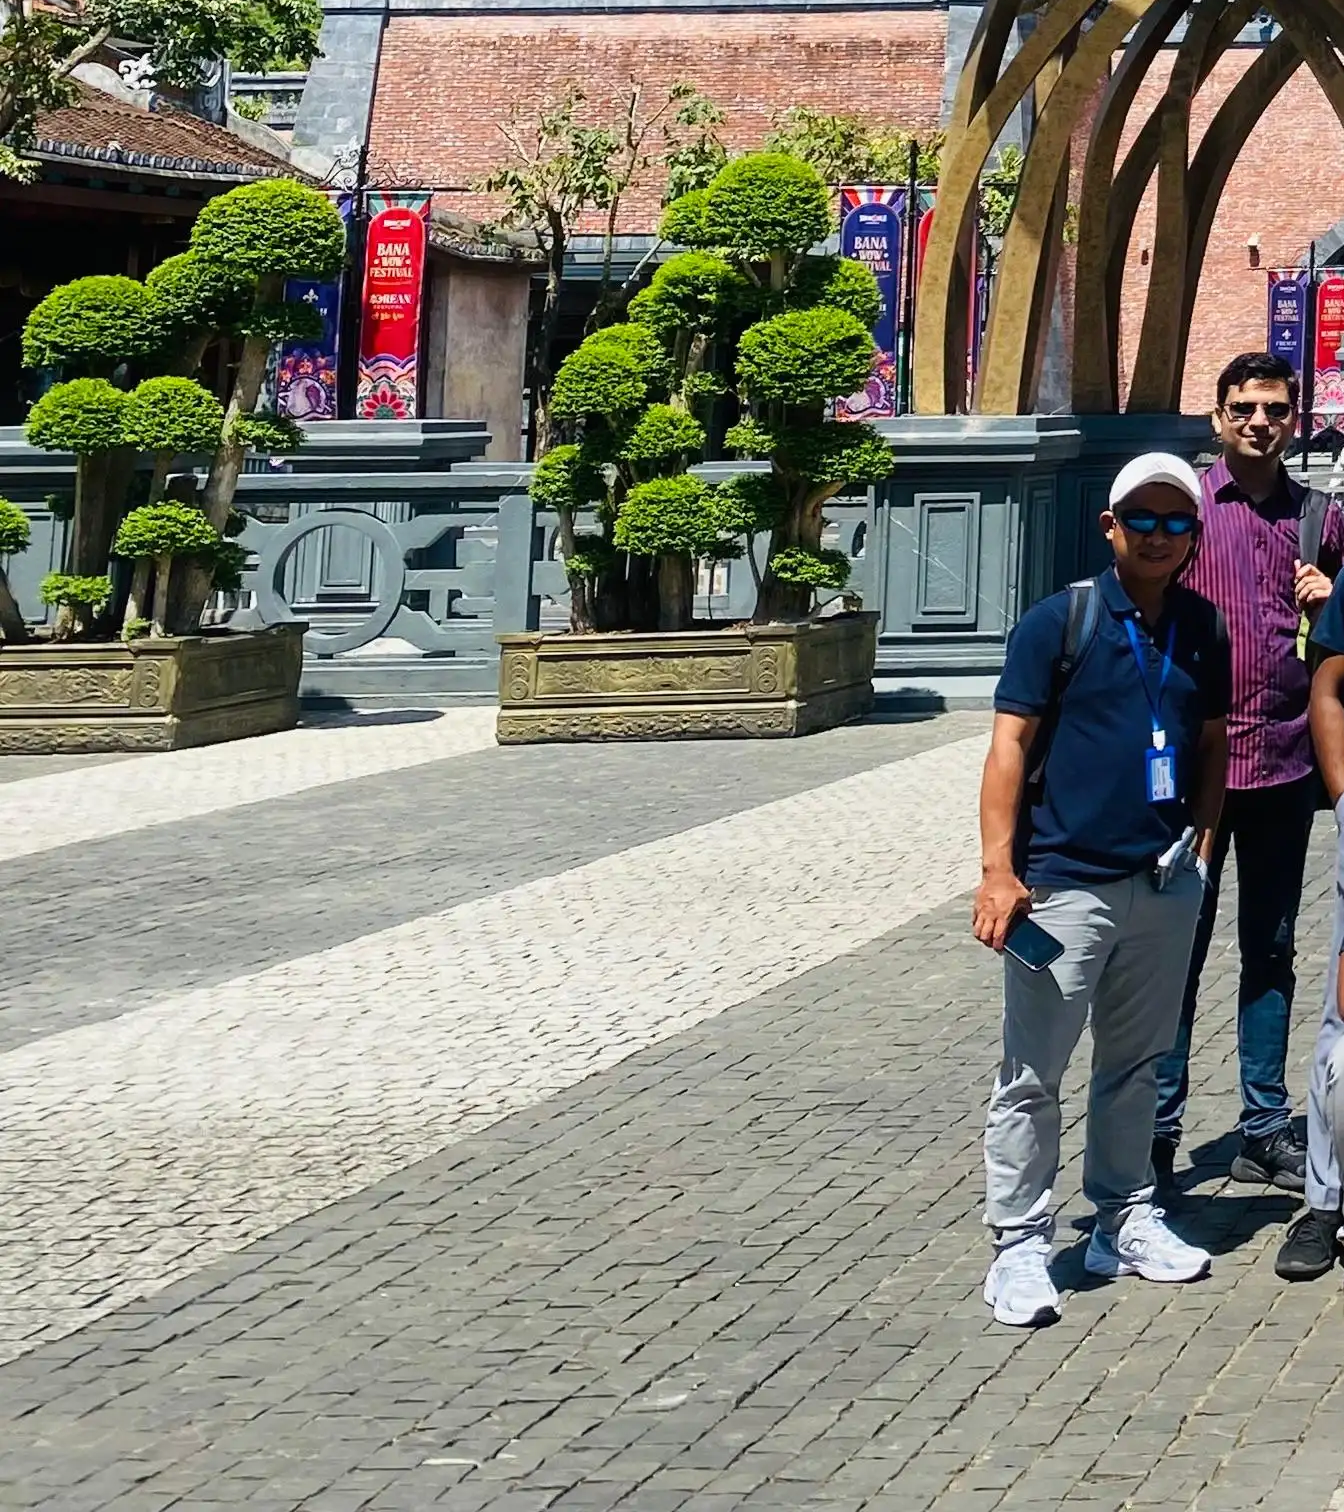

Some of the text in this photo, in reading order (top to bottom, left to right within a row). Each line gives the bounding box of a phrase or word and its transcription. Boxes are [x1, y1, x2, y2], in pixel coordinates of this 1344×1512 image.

[854, 236, 888, 249] BANA
[377, 242, 410, 257] BANA
[858, 250, 883, 260] WOW
[381, 256, 404, 267] WOW
[369, 267, 413, 278] FESTIVAL
[1278, 300, 1298, 308] BANA
[1325, 299, 1344, 308] BANA
